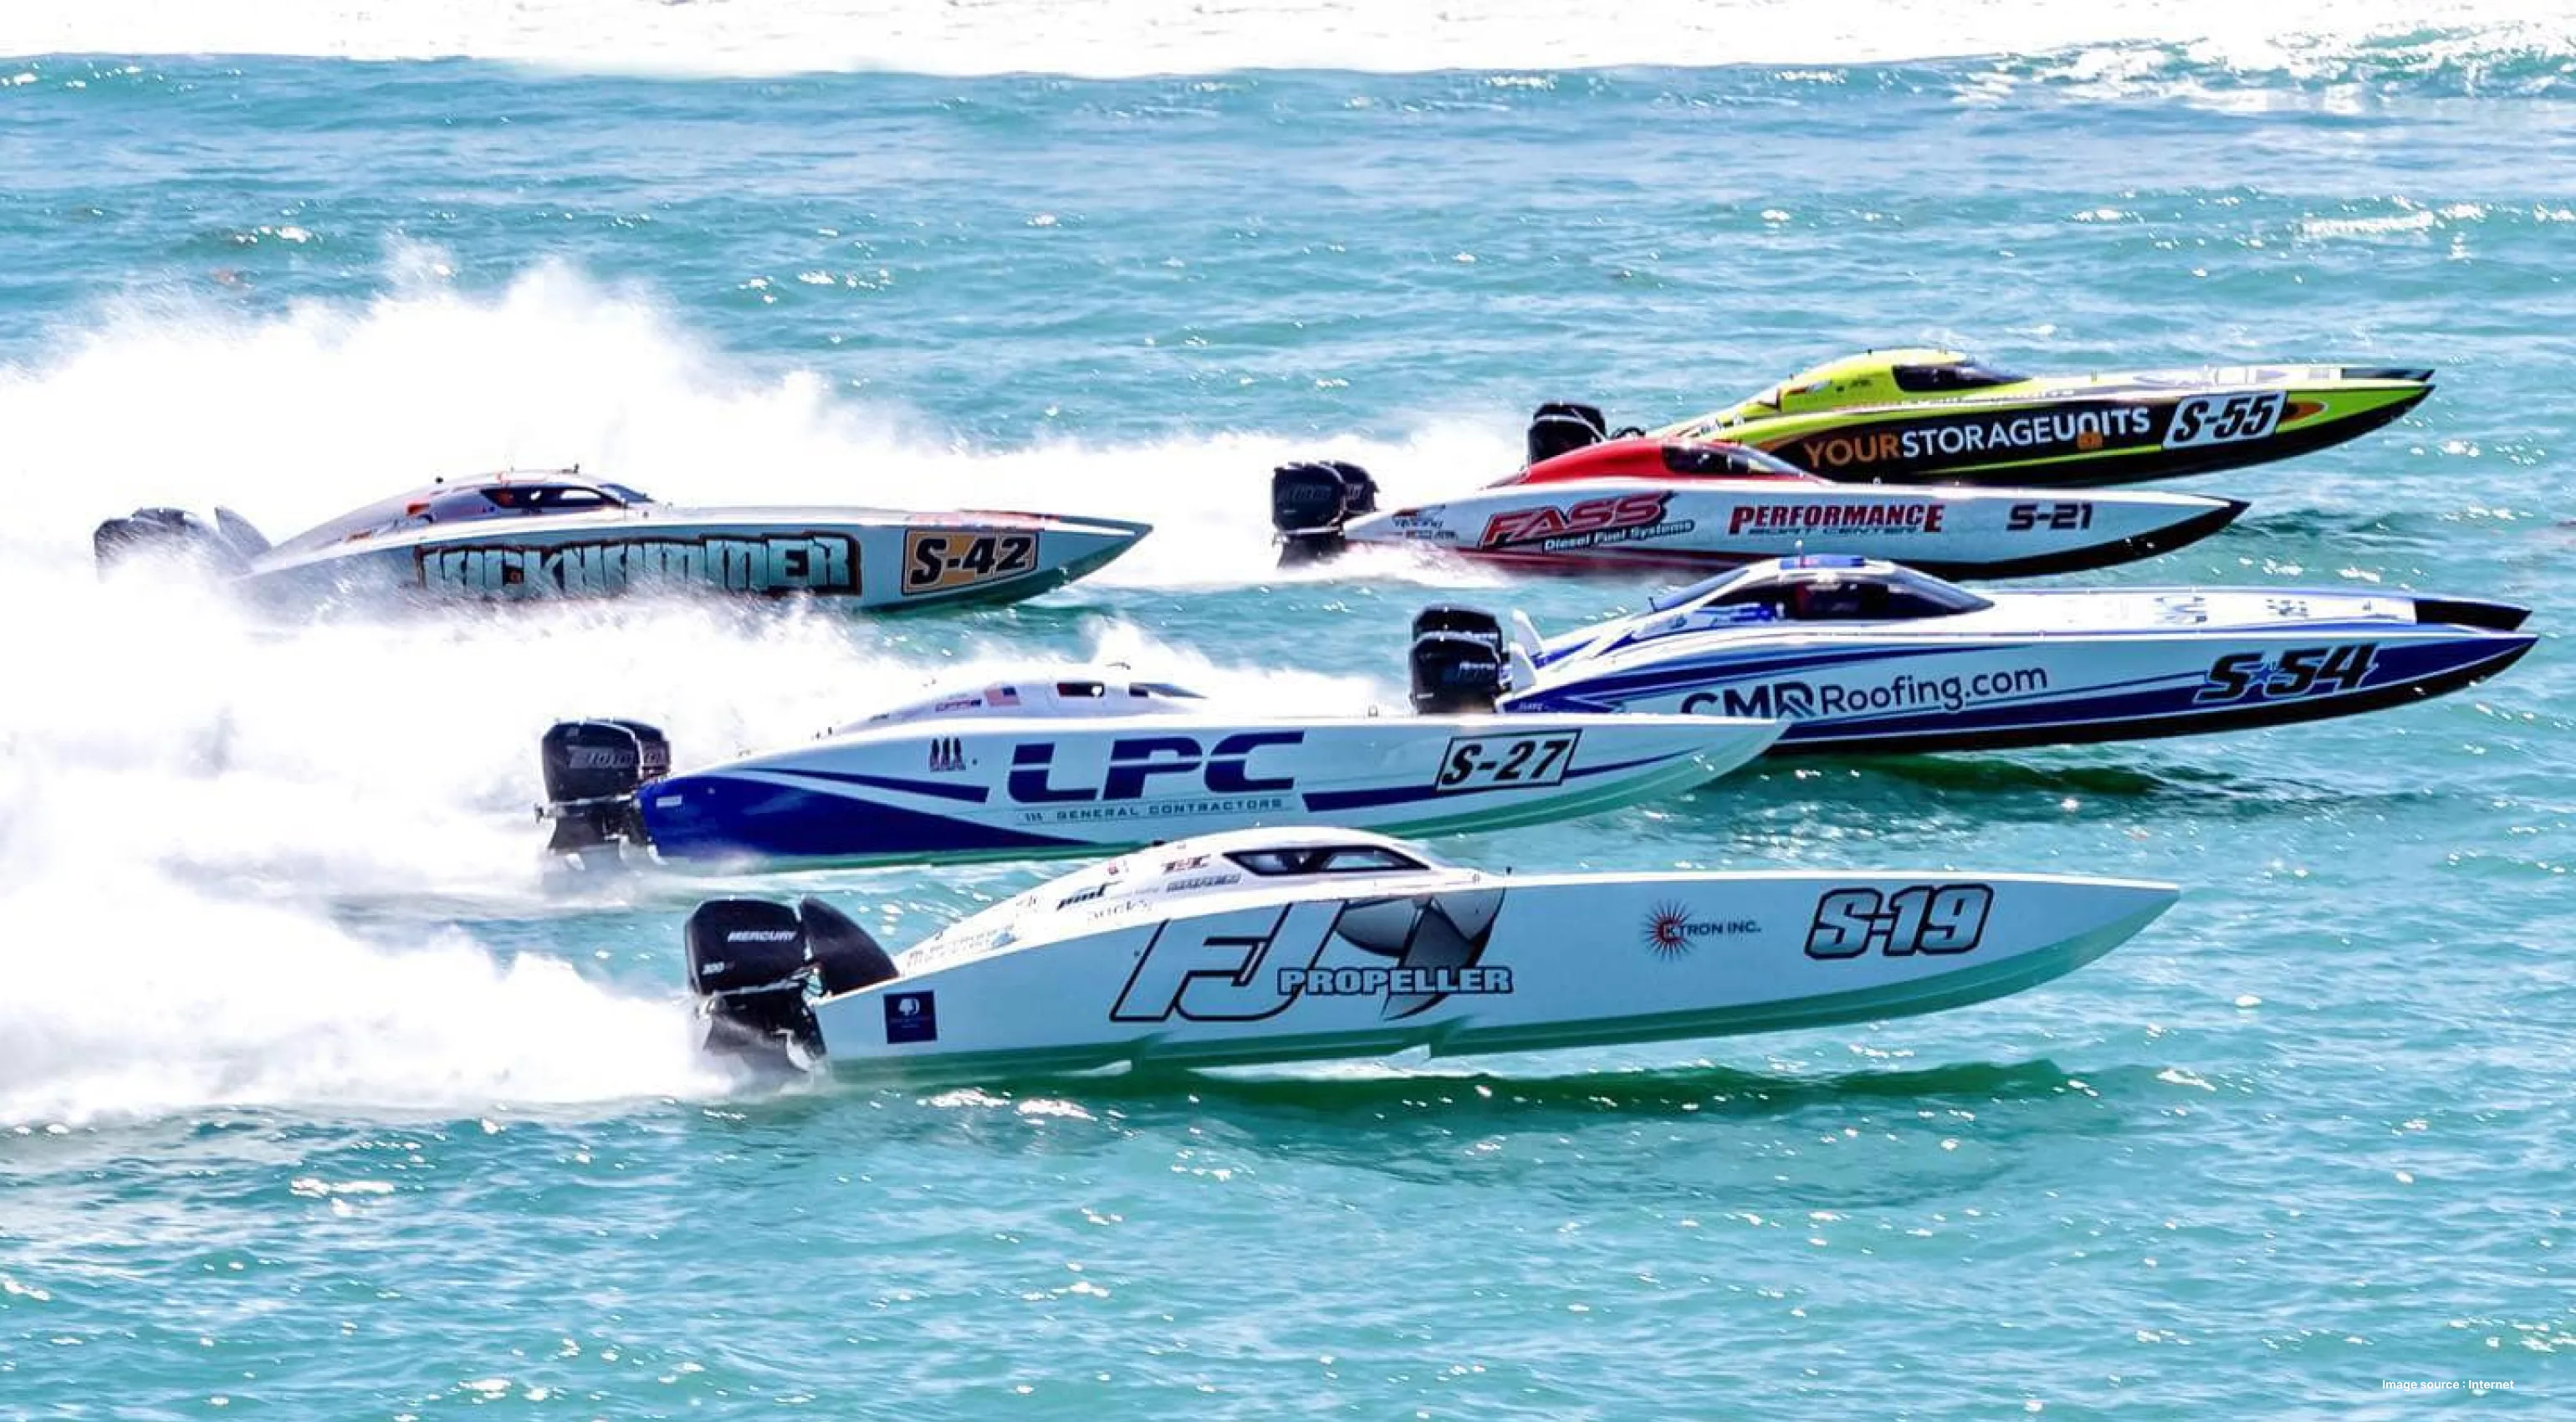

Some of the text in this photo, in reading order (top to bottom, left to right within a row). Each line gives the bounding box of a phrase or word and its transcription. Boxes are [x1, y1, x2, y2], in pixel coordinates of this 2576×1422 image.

[2175, 393, 2278, 442] S-55
[1478, 492, 1671, 548] FASS
[1729, 504, 1945, 535] PERFORMANCE
[2007, 504, 2092, 529] S-21
[910, 538, 1031, 584] S-42
[1820, 668, 2047, 714] Roofing.com
[1008, 732, 1304, 803] LPC
[1441, 739, 1572, 785] S-27
[1056, 799, 1282, 820] GENERAL CONTRACTORS
[728, 930, 796, 942] MERCURY
[1727, 919, 1761, 934] INC.
[1804, 883, 1994, 960] S-19
[1277, 966, 1513, 996] PROPELLER
